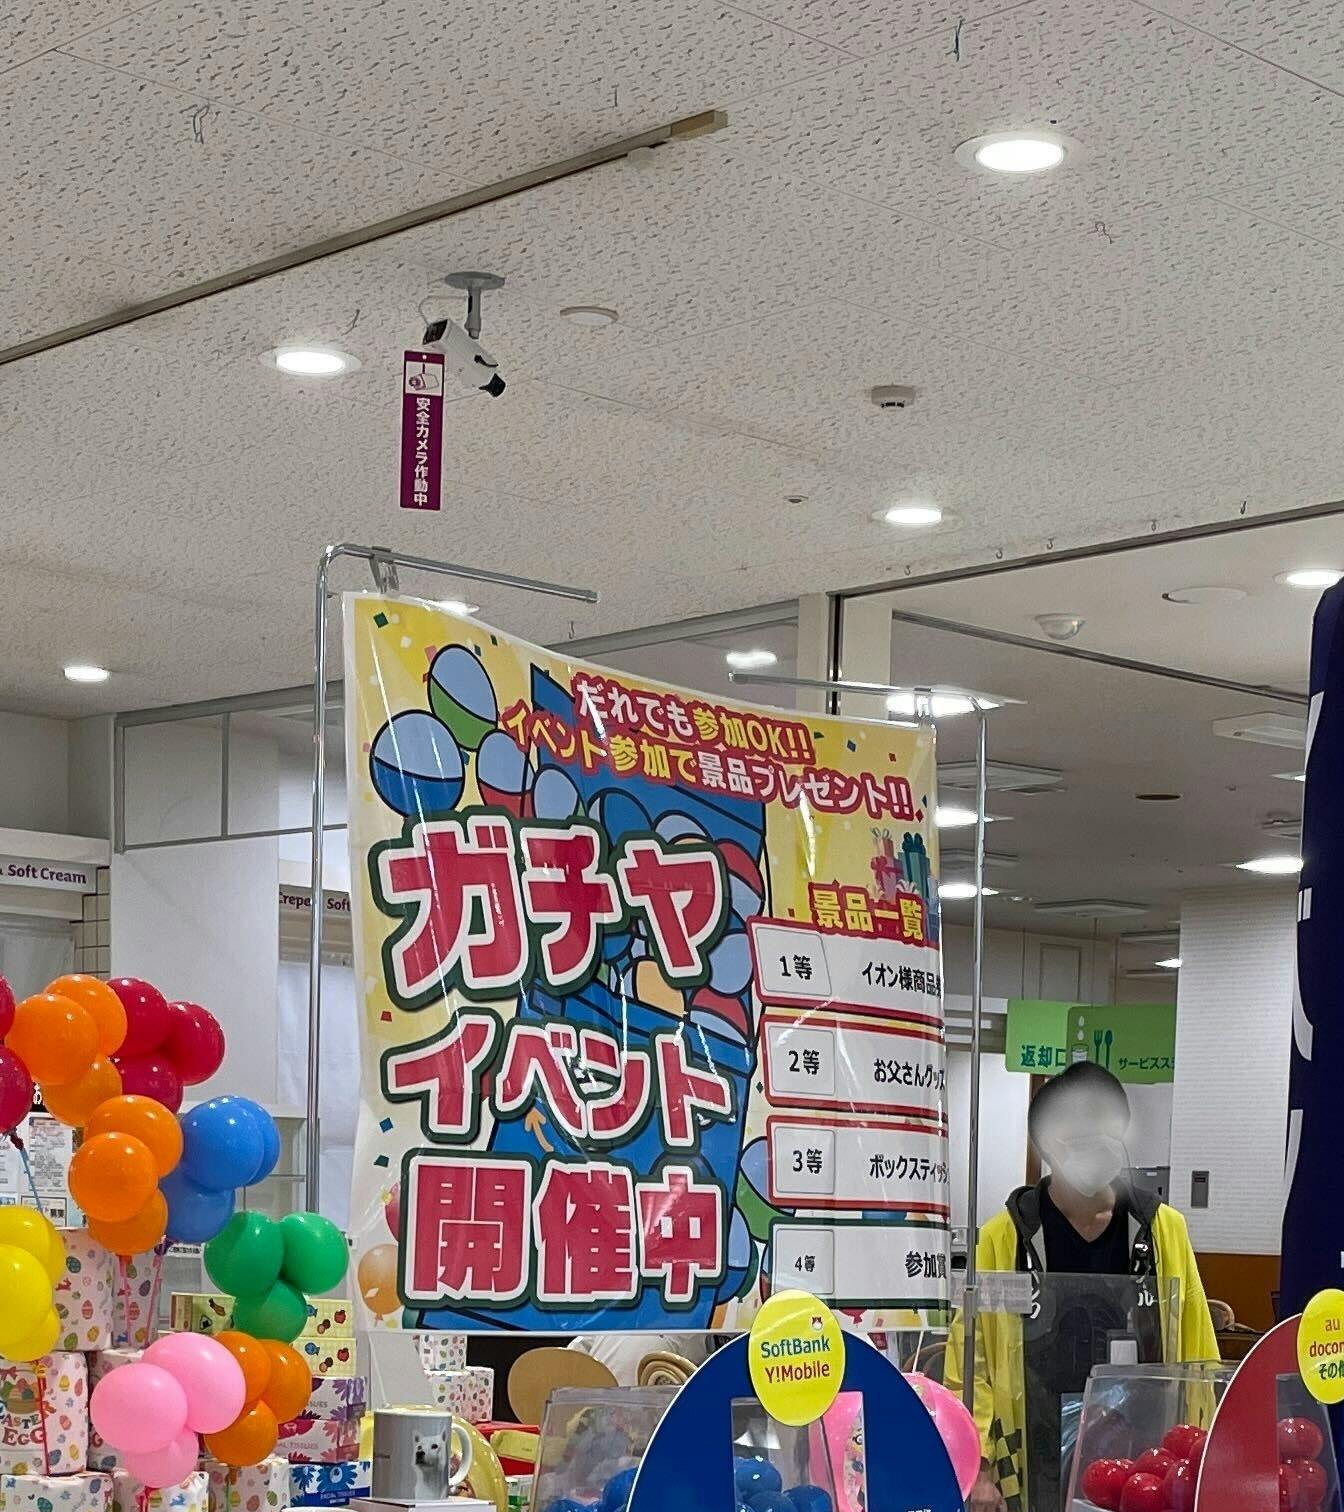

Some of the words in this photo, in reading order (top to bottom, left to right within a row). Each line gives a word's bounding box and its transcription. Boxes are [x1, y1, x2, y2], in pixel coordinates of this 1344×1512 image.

[413, 396, 431, 507] 安全カメラ作動中
[574, 677, 812, 761] だれでも参加OK!!
[506, 707, 912, 815] イベント参加で景品プレゼント!!
[7, 863, 38, 879] Soft
[40, 867, 87, 885] Cream
[386, 822, 719, 993] ガチャ
[812, 888, 924, 941] 景品一覧
[778, 954, 813, 981] 1等
[788, 1049, 820, 1076] 2等
[1118, 1056, 1175, 1070] サービスス
[386, 1016, 730, 1151] イベント
[792, 1148, 823, 1175] 3等
[411, 1160, 725, 1301] 開催中
[794, 1254, 816, 1273] 4等
[1325, 1318, 1341, 1331] au
[760, 1335, 831, 1358] SoftBank
[764, 1360, 830, 1384] Y!Mobile
